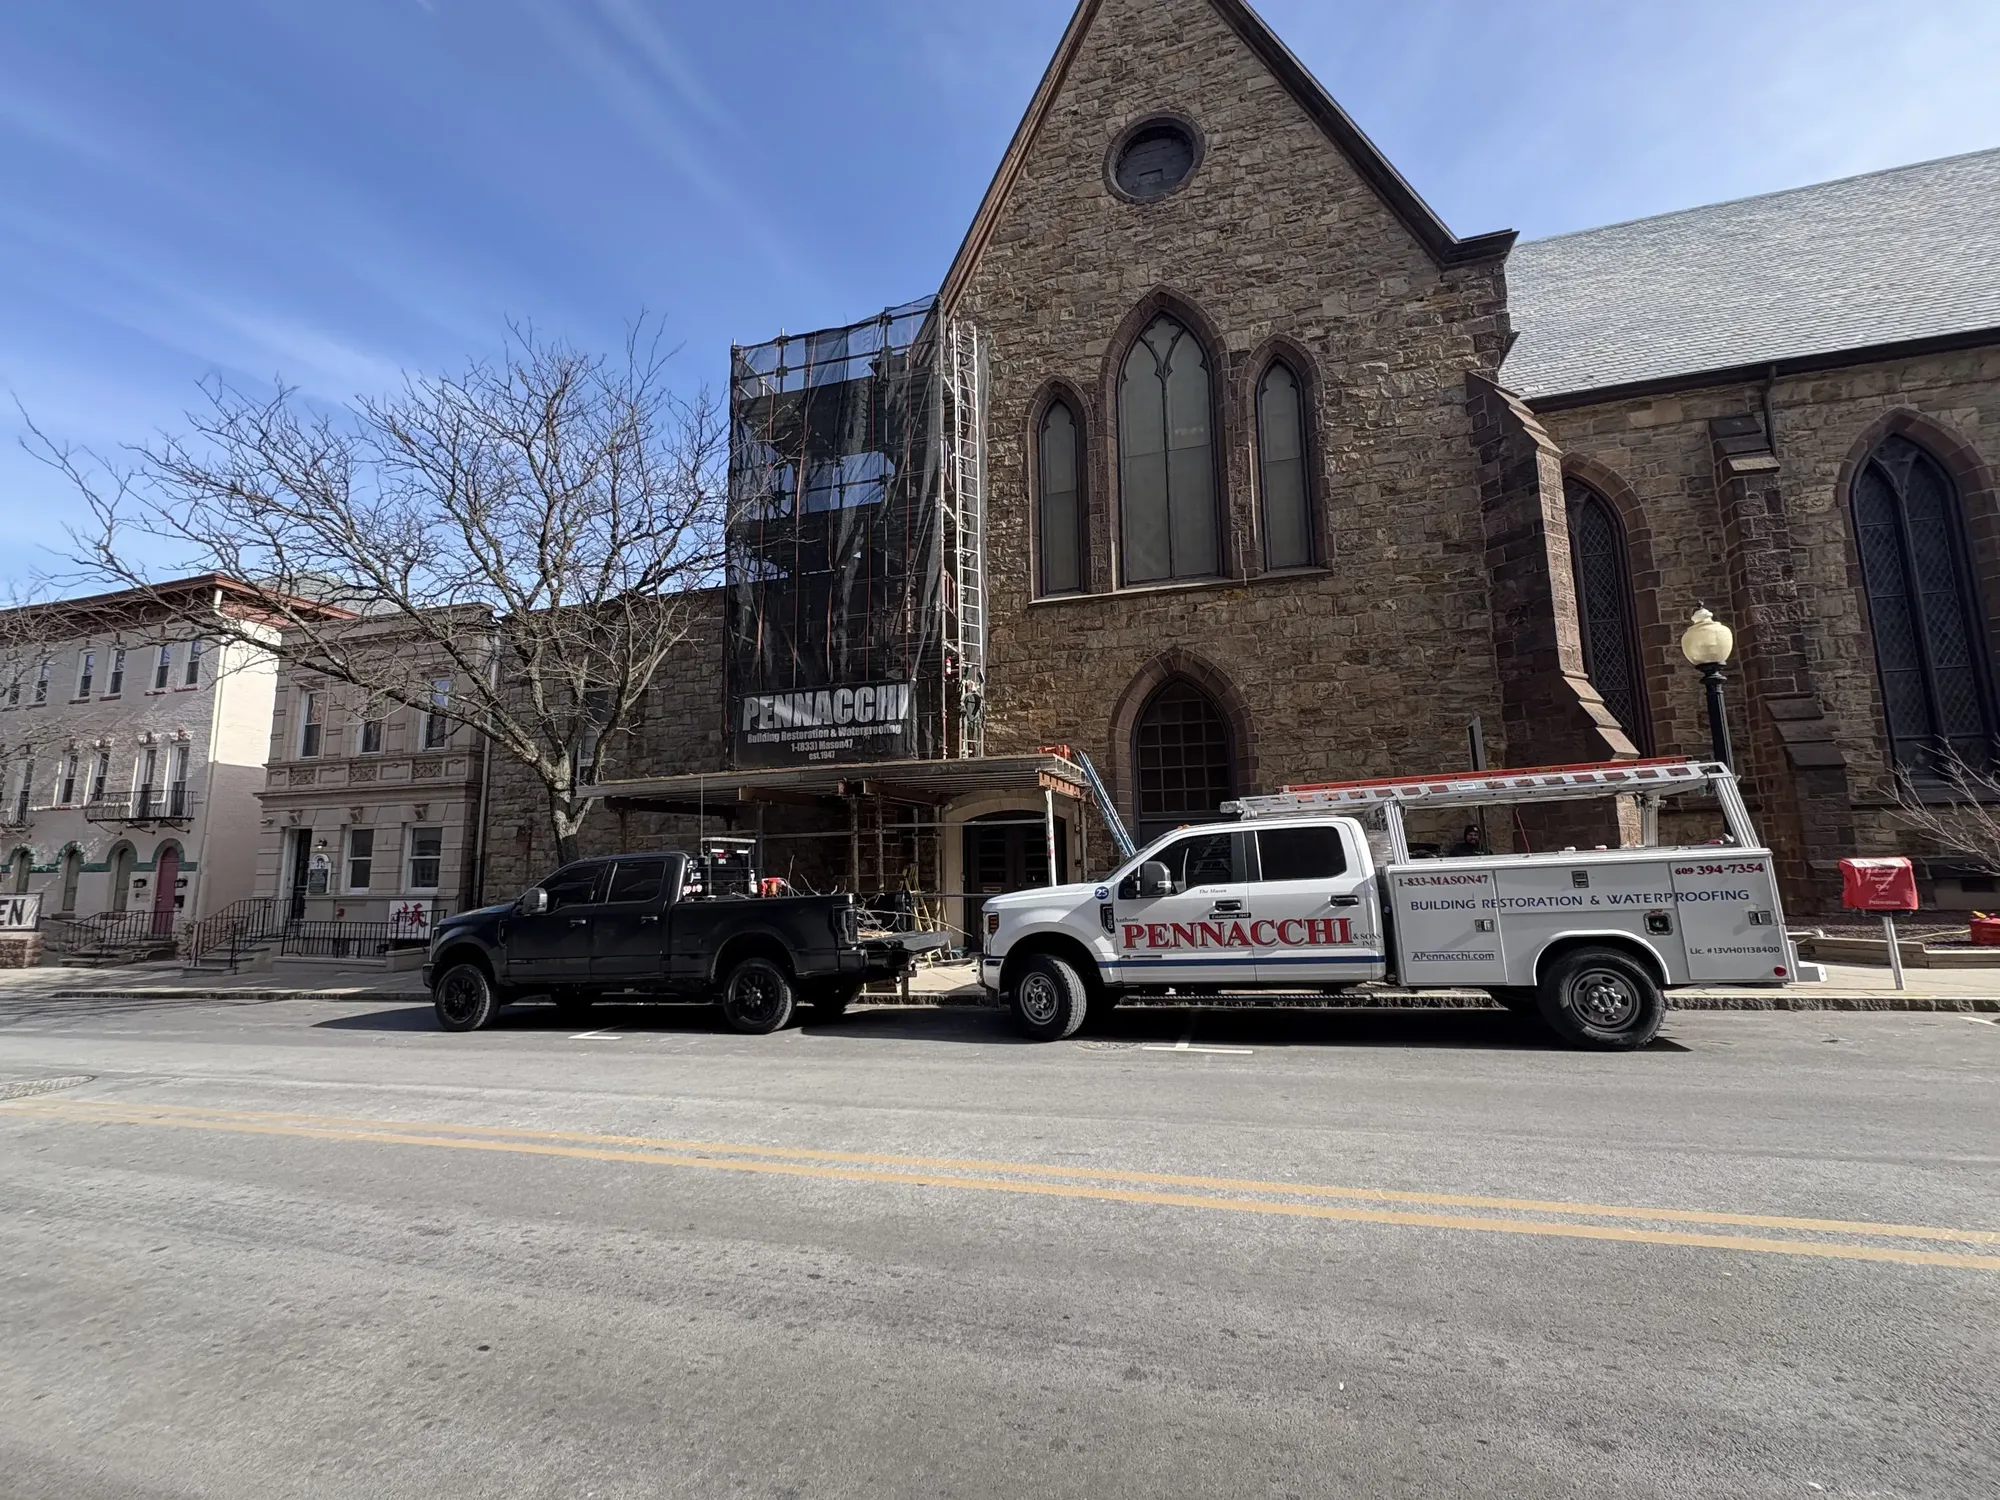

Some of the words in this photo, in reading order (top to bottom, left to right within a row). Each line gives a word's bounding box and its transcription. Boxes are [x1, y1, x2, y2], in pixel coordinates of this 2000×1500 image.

[743, 684, 909, 731] PENNACCHI
[747, 732, 780, 743] Building
[781, 729, 829, 740] Restoration
[830, 729, 837, 737] &
[818, 739, 853, 750] Mason47
[1674, 867, 1694, 876] 609
[1697, 863, 1764, 875] 394-7354
[1398, 875, 1488, 887] 1-833-MASON47
[1096, 888, 1108, 897] 25
[1410, 900, 1476, 911] BUILDING
[1482, 896, 1583, 909] RESTORATION
[1590, 895, 1601, 905] &
[1606, 890, 1750, 905] WATERPROOFING
[1121, 917, 1355, 949] PENNACCHI
[1360, 932, 1382, 940] SONS
[1412, 952, 1495, 960] APennacchi.com
[1689, 947, 1704, 955] Lic.
[1707, 946, 1780, 954] #13VH01138400
